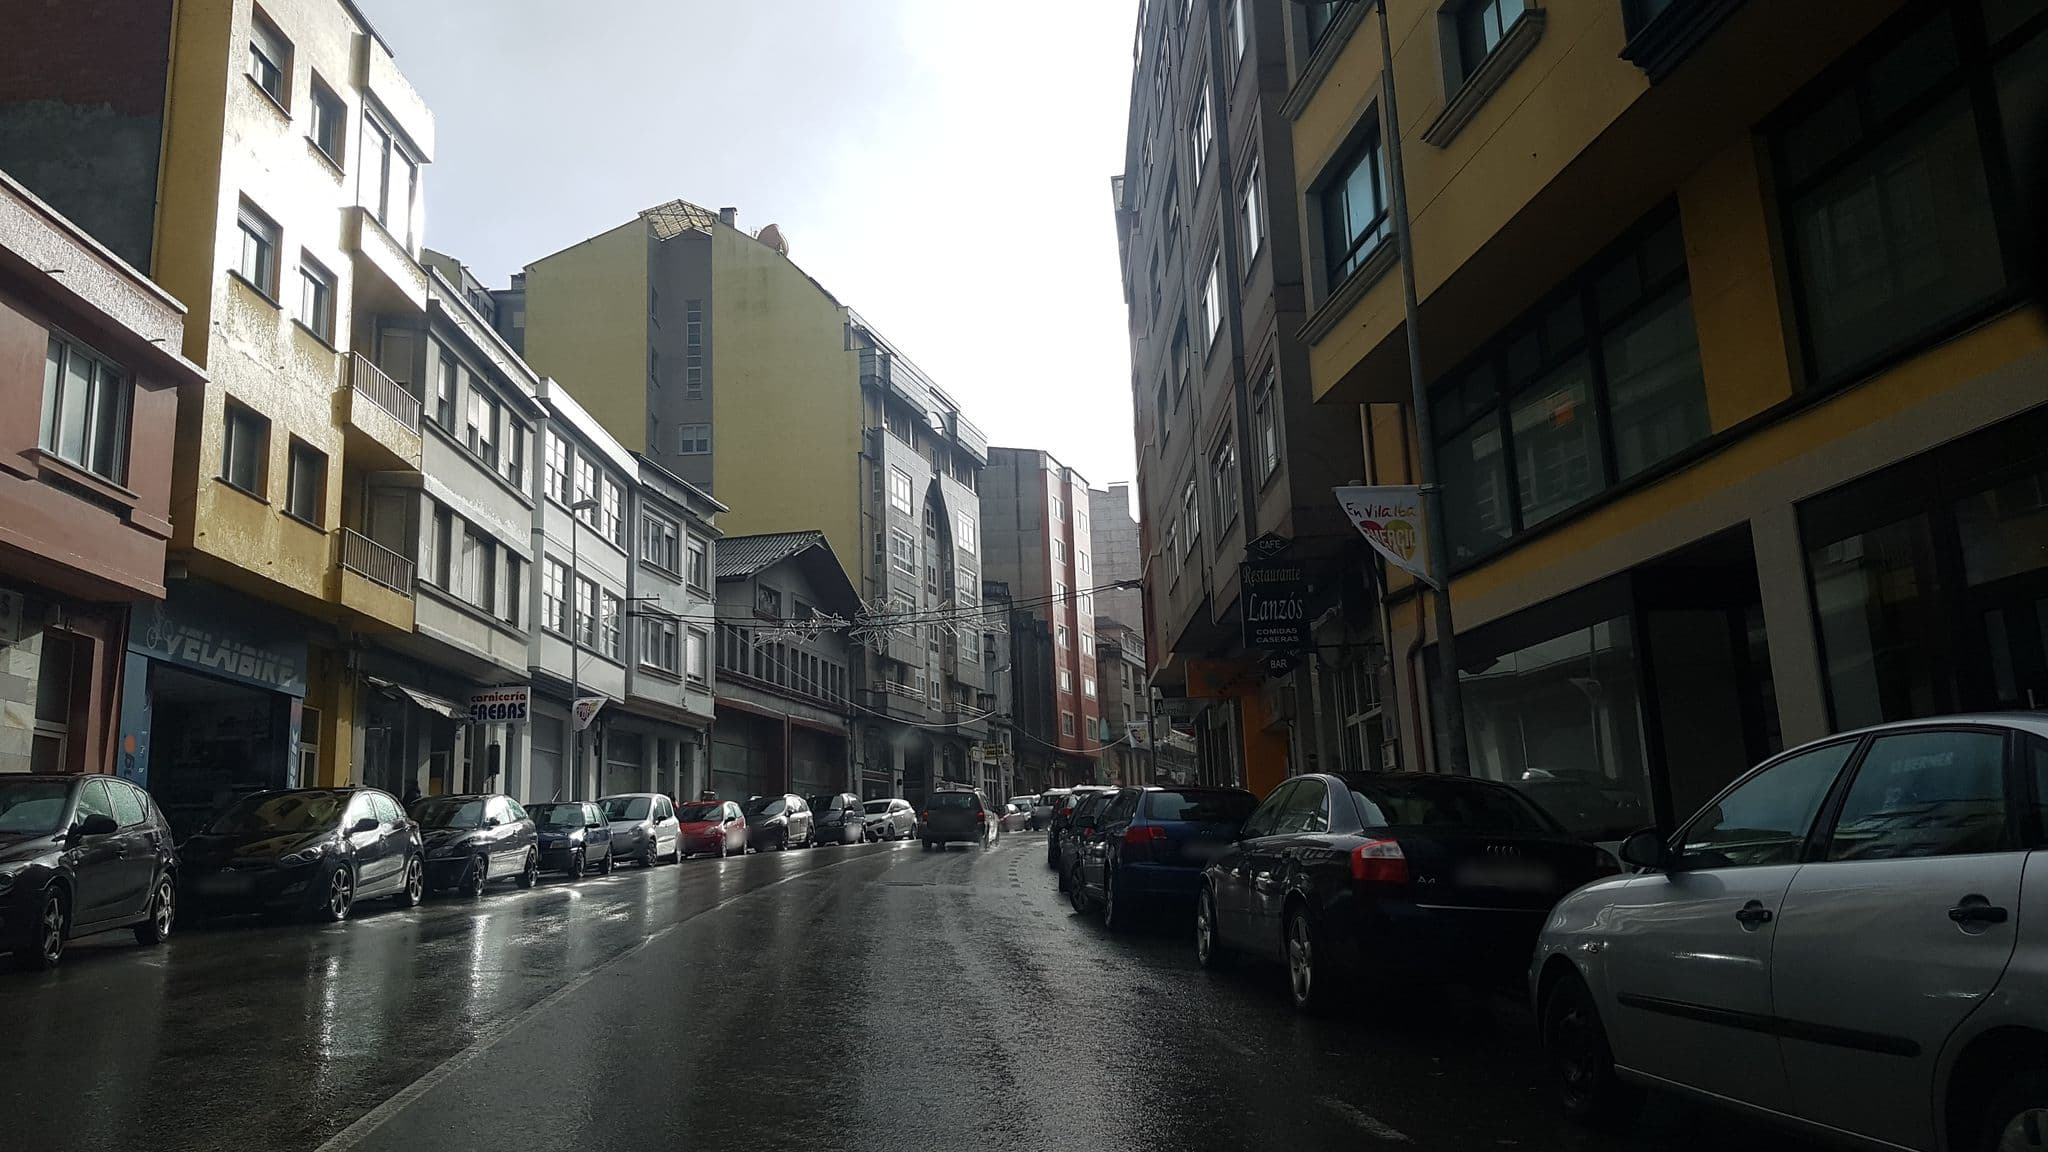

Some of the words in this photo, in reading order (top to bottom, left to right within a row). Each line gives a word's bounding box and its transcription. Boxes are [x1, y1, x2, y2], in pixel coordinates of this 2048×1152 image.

[1346, 502, 1362, 518] En
[1365, 503, 1417, 518] Vilalba
[1243, 565, 1302, 587] Restaurante
[1247, 592, 1304, 622] Lanzós
[1255, 627, 1298, 636] COMIDAS
[1255, 636, 1300, 644] CASERAS
[1270, 658, 1288, 669] BAR
[1416, 875, 1436, 885] A4
